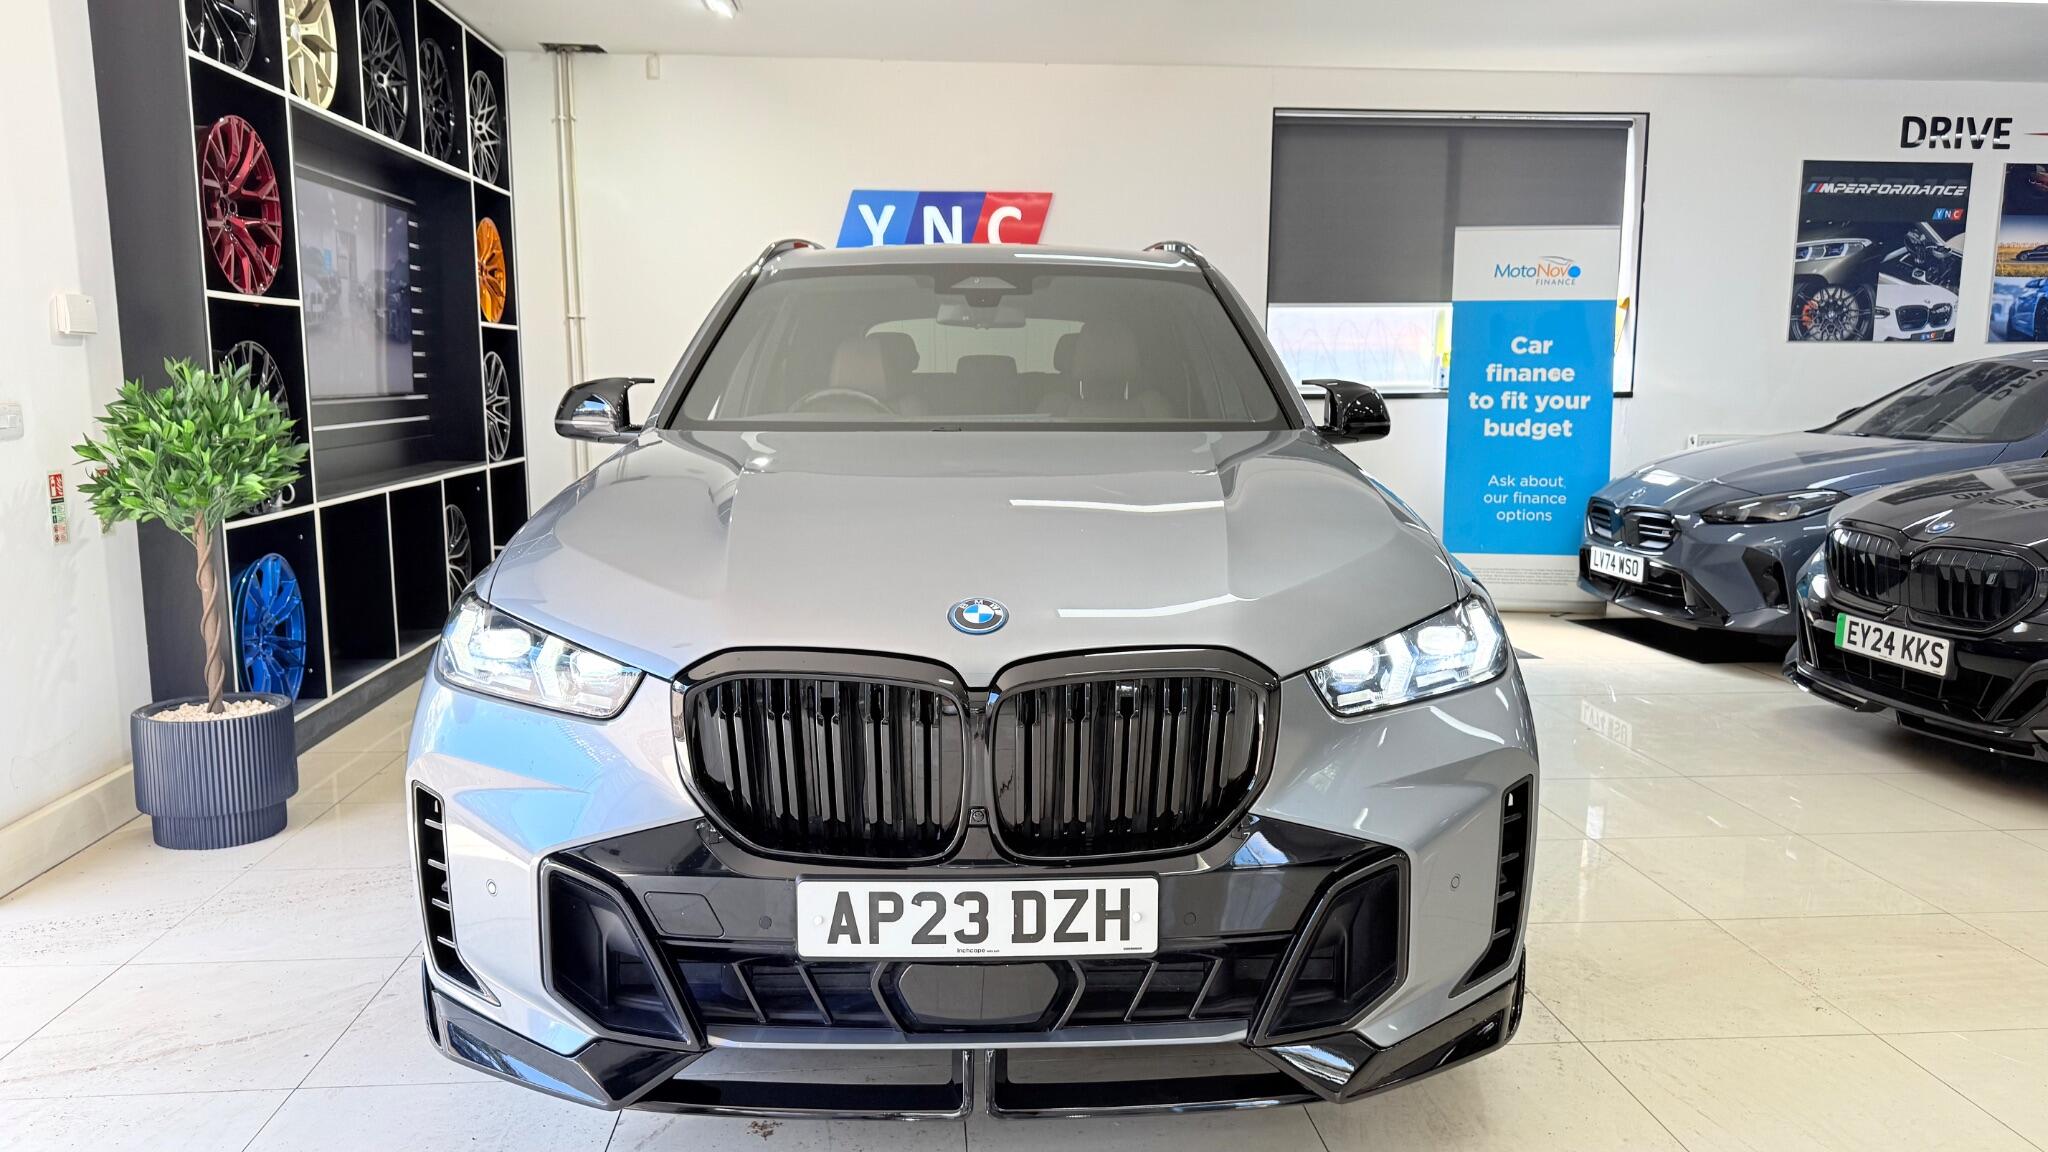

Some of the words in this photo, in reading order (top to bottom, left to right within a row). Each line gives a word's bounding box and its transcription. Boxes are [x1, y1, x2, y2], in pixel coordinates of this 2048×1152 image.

[1900, 116, 2013, 149] DRIVE
[1536, 278, 1576, 286] FINANCE
[1511, 336, 1553, 355] Car
[1486, 363, 1576, 382] finance
[1468, 392, 1494, 409] to
[1501, 391, 1528, 409] fit
[1534, 395, 1591, 413] your
[1483, 418, 1573, 440] budget
[1488, 475, 1515, 487] Ask
[1520, 475, 1564, 488] about
[1483, 494, 1508, 504] our
[1513, 492, 1567, 505] finance
[1496, 509, 1552, 522] options
[1594, 549, 1616, 572] LV74
[1847, 620, 1895, 656] EY24
[1901, 634, 1944, 668] KKS
[827, 891, 989, 945] AP23
[1011, 888, 1131, 944] DZH
